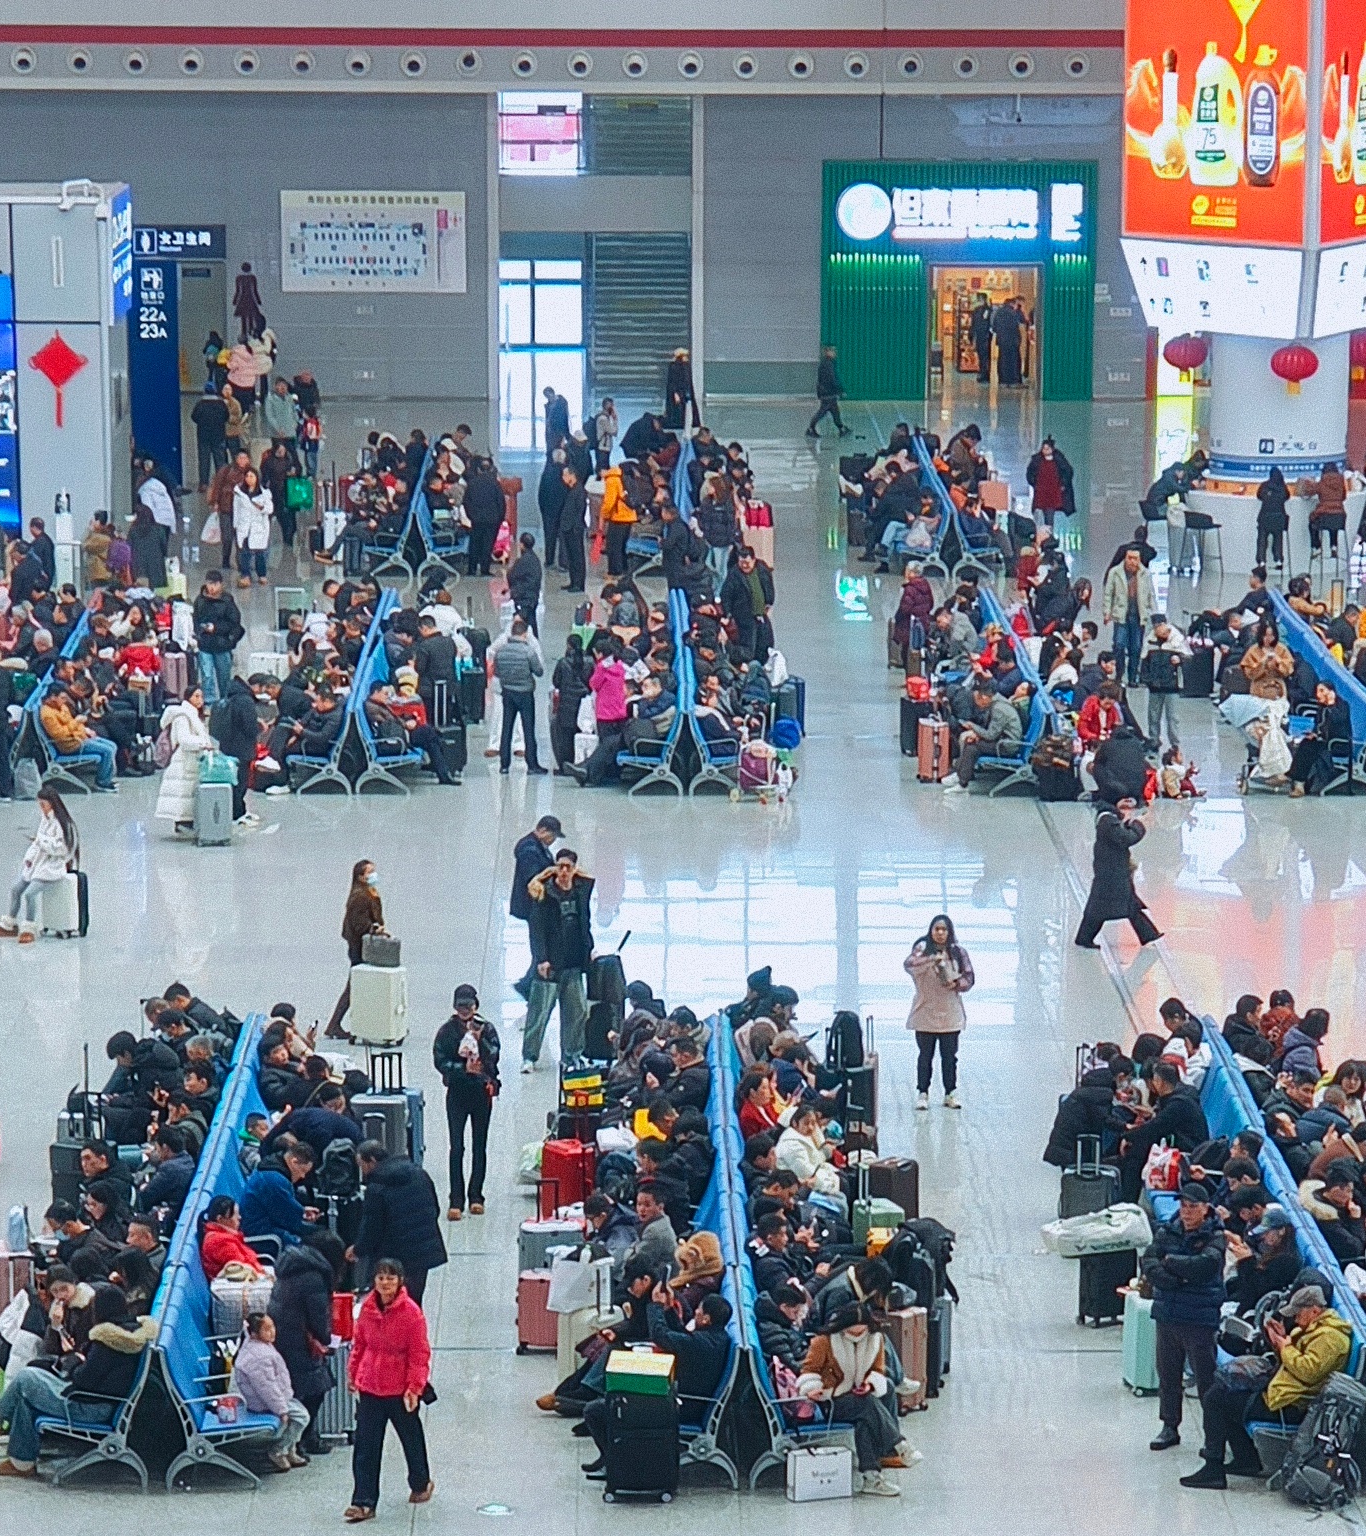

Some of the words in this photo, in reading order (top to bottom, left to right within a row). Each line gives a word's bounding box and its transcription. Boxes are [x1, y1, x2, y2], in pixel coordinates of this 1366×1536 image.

[159, 231, 211, 247] 女卫生间
[139, 307, 167, 322] 22A
[139, 323, 168, 339] 23A
